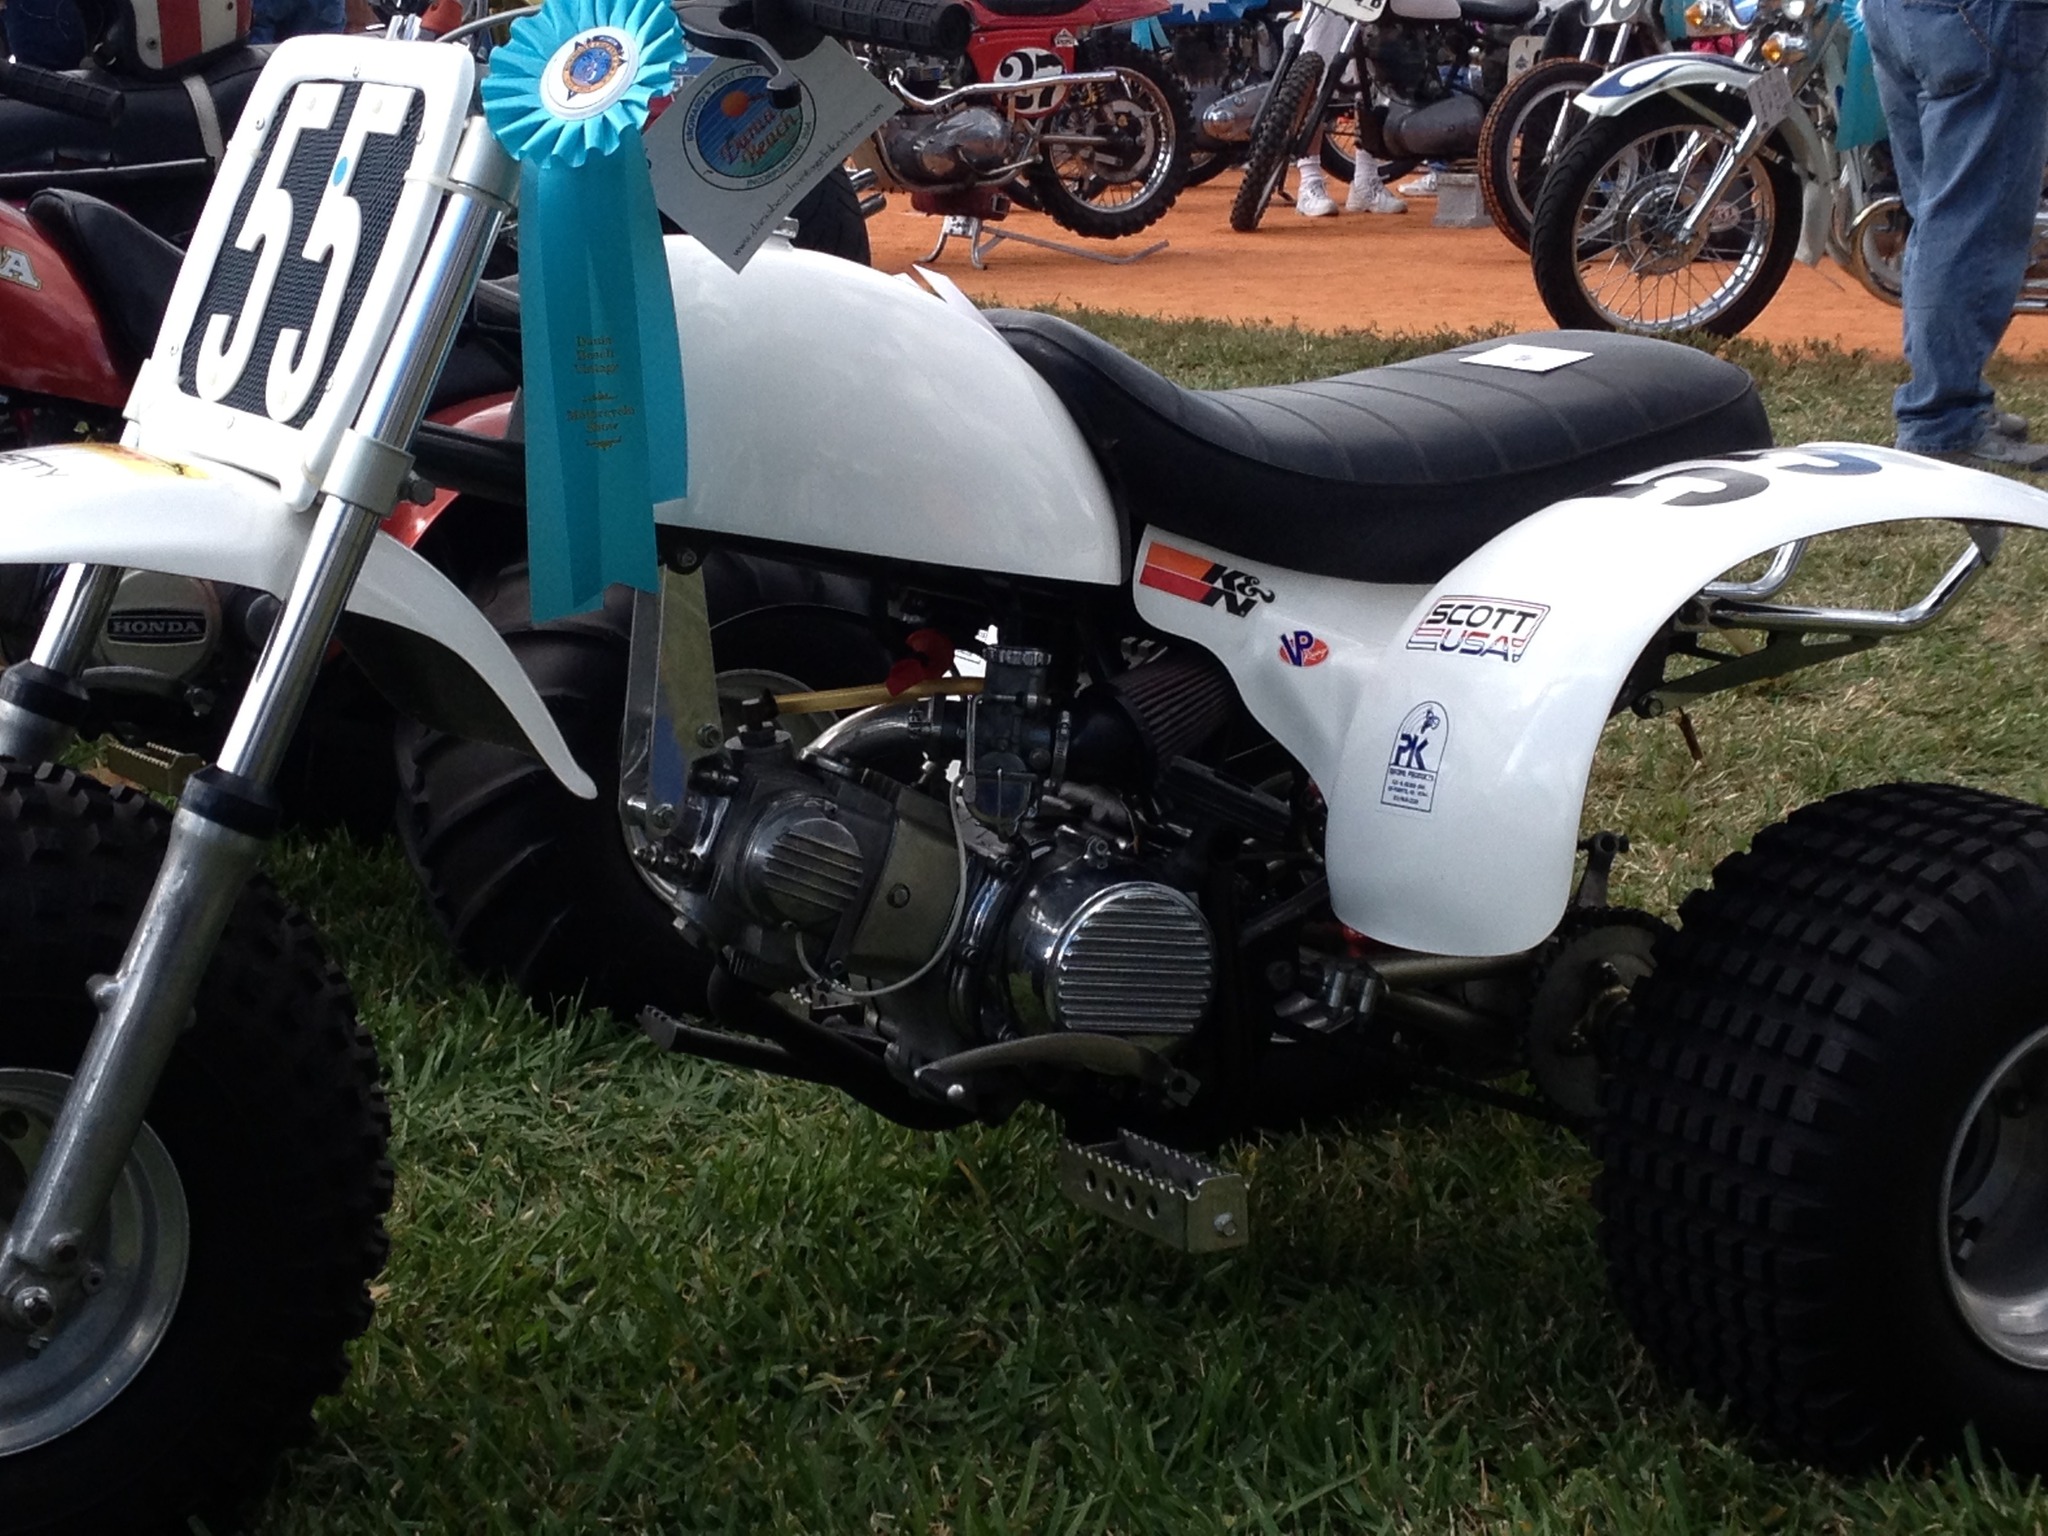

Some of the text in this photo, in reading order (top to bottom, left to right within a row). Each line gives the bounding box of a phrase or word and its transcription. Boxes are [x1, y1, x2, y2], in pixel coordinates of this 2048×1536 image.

[711, 69, 736, 90] FIRST
[720, 107, 777, 166] Dania
[741, 108, 800, 168] Beach
[195, 82, 415, 423] 55
[1201, 563, 1275, 618] K&N
[113, 621, 200, 633] HONDA
[1425, 603, 1538, 634] SCOTT
[1281, 630, 1314, 667] VP
[1439, 628, 1509, 663] USA
[1394, 733, 1429, 770] PK
